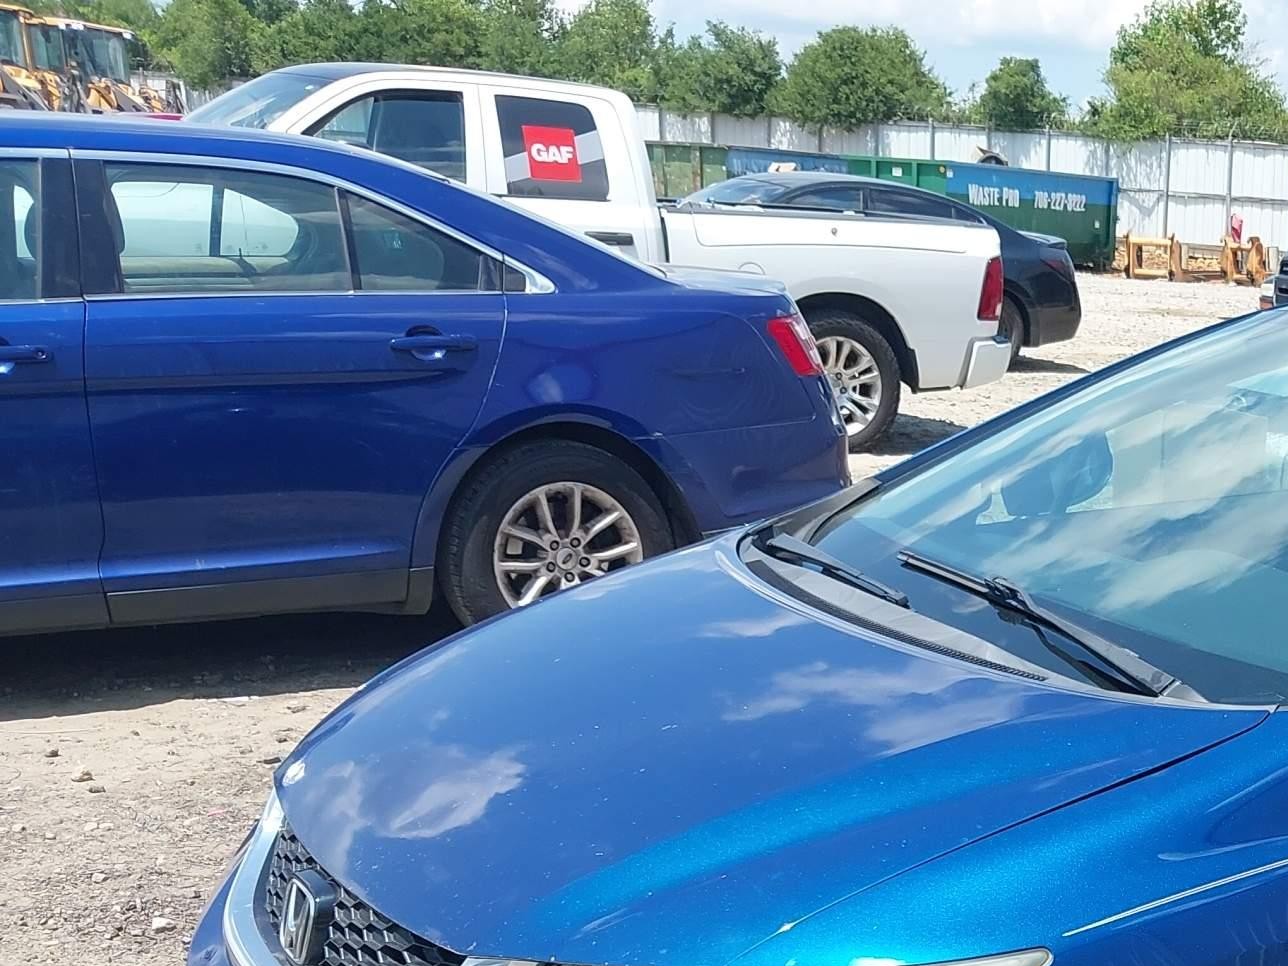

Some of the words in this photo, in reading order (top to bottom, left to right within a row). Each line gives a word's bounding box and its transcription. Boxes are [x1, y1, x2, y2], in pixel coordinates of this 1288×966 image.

[530, 142, 574, 164] GAF
[967, 183, 1000, 207] WASTE
[1002, 187, 1020, 208] PRO
